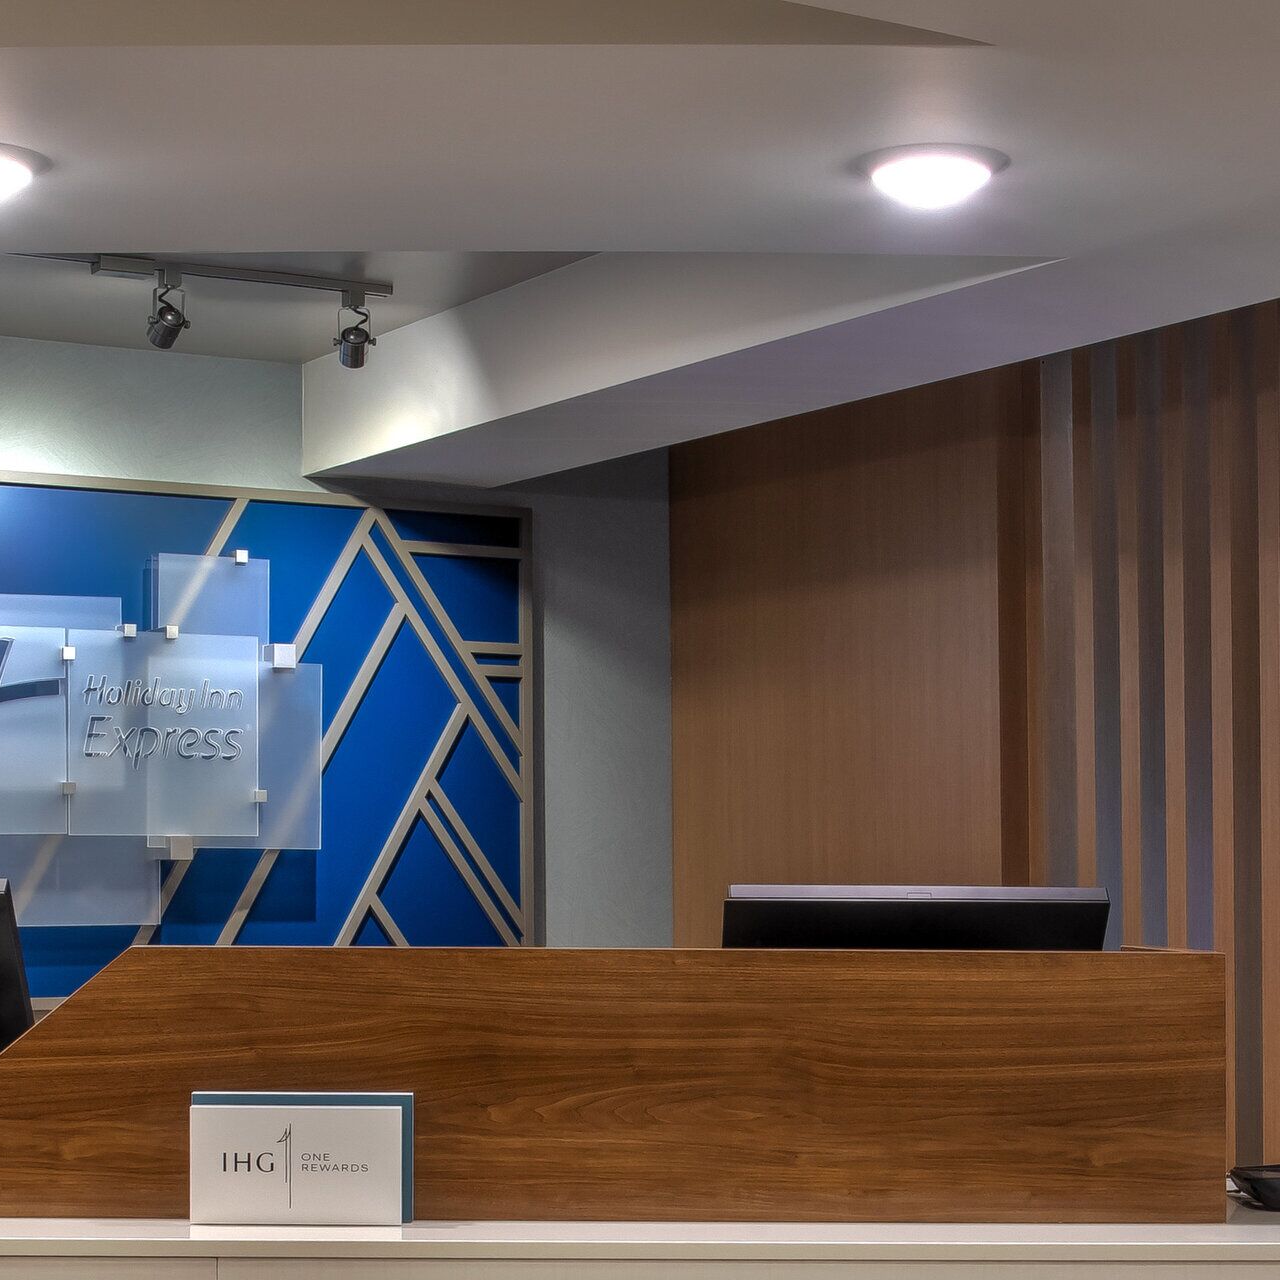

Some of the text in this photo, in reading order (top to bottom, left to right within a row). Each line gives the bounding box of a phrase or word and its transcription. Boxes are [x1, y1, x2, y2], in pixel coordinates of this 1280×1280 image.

[82, 674, 244, 715] Holiday Inn
[83, 714, 244, 771] Express
[222, 1152, 275, 1173] IHG
[301, 1153, 330, 1162] ONE
[301, 1163, 369, 1173] REWARDS
